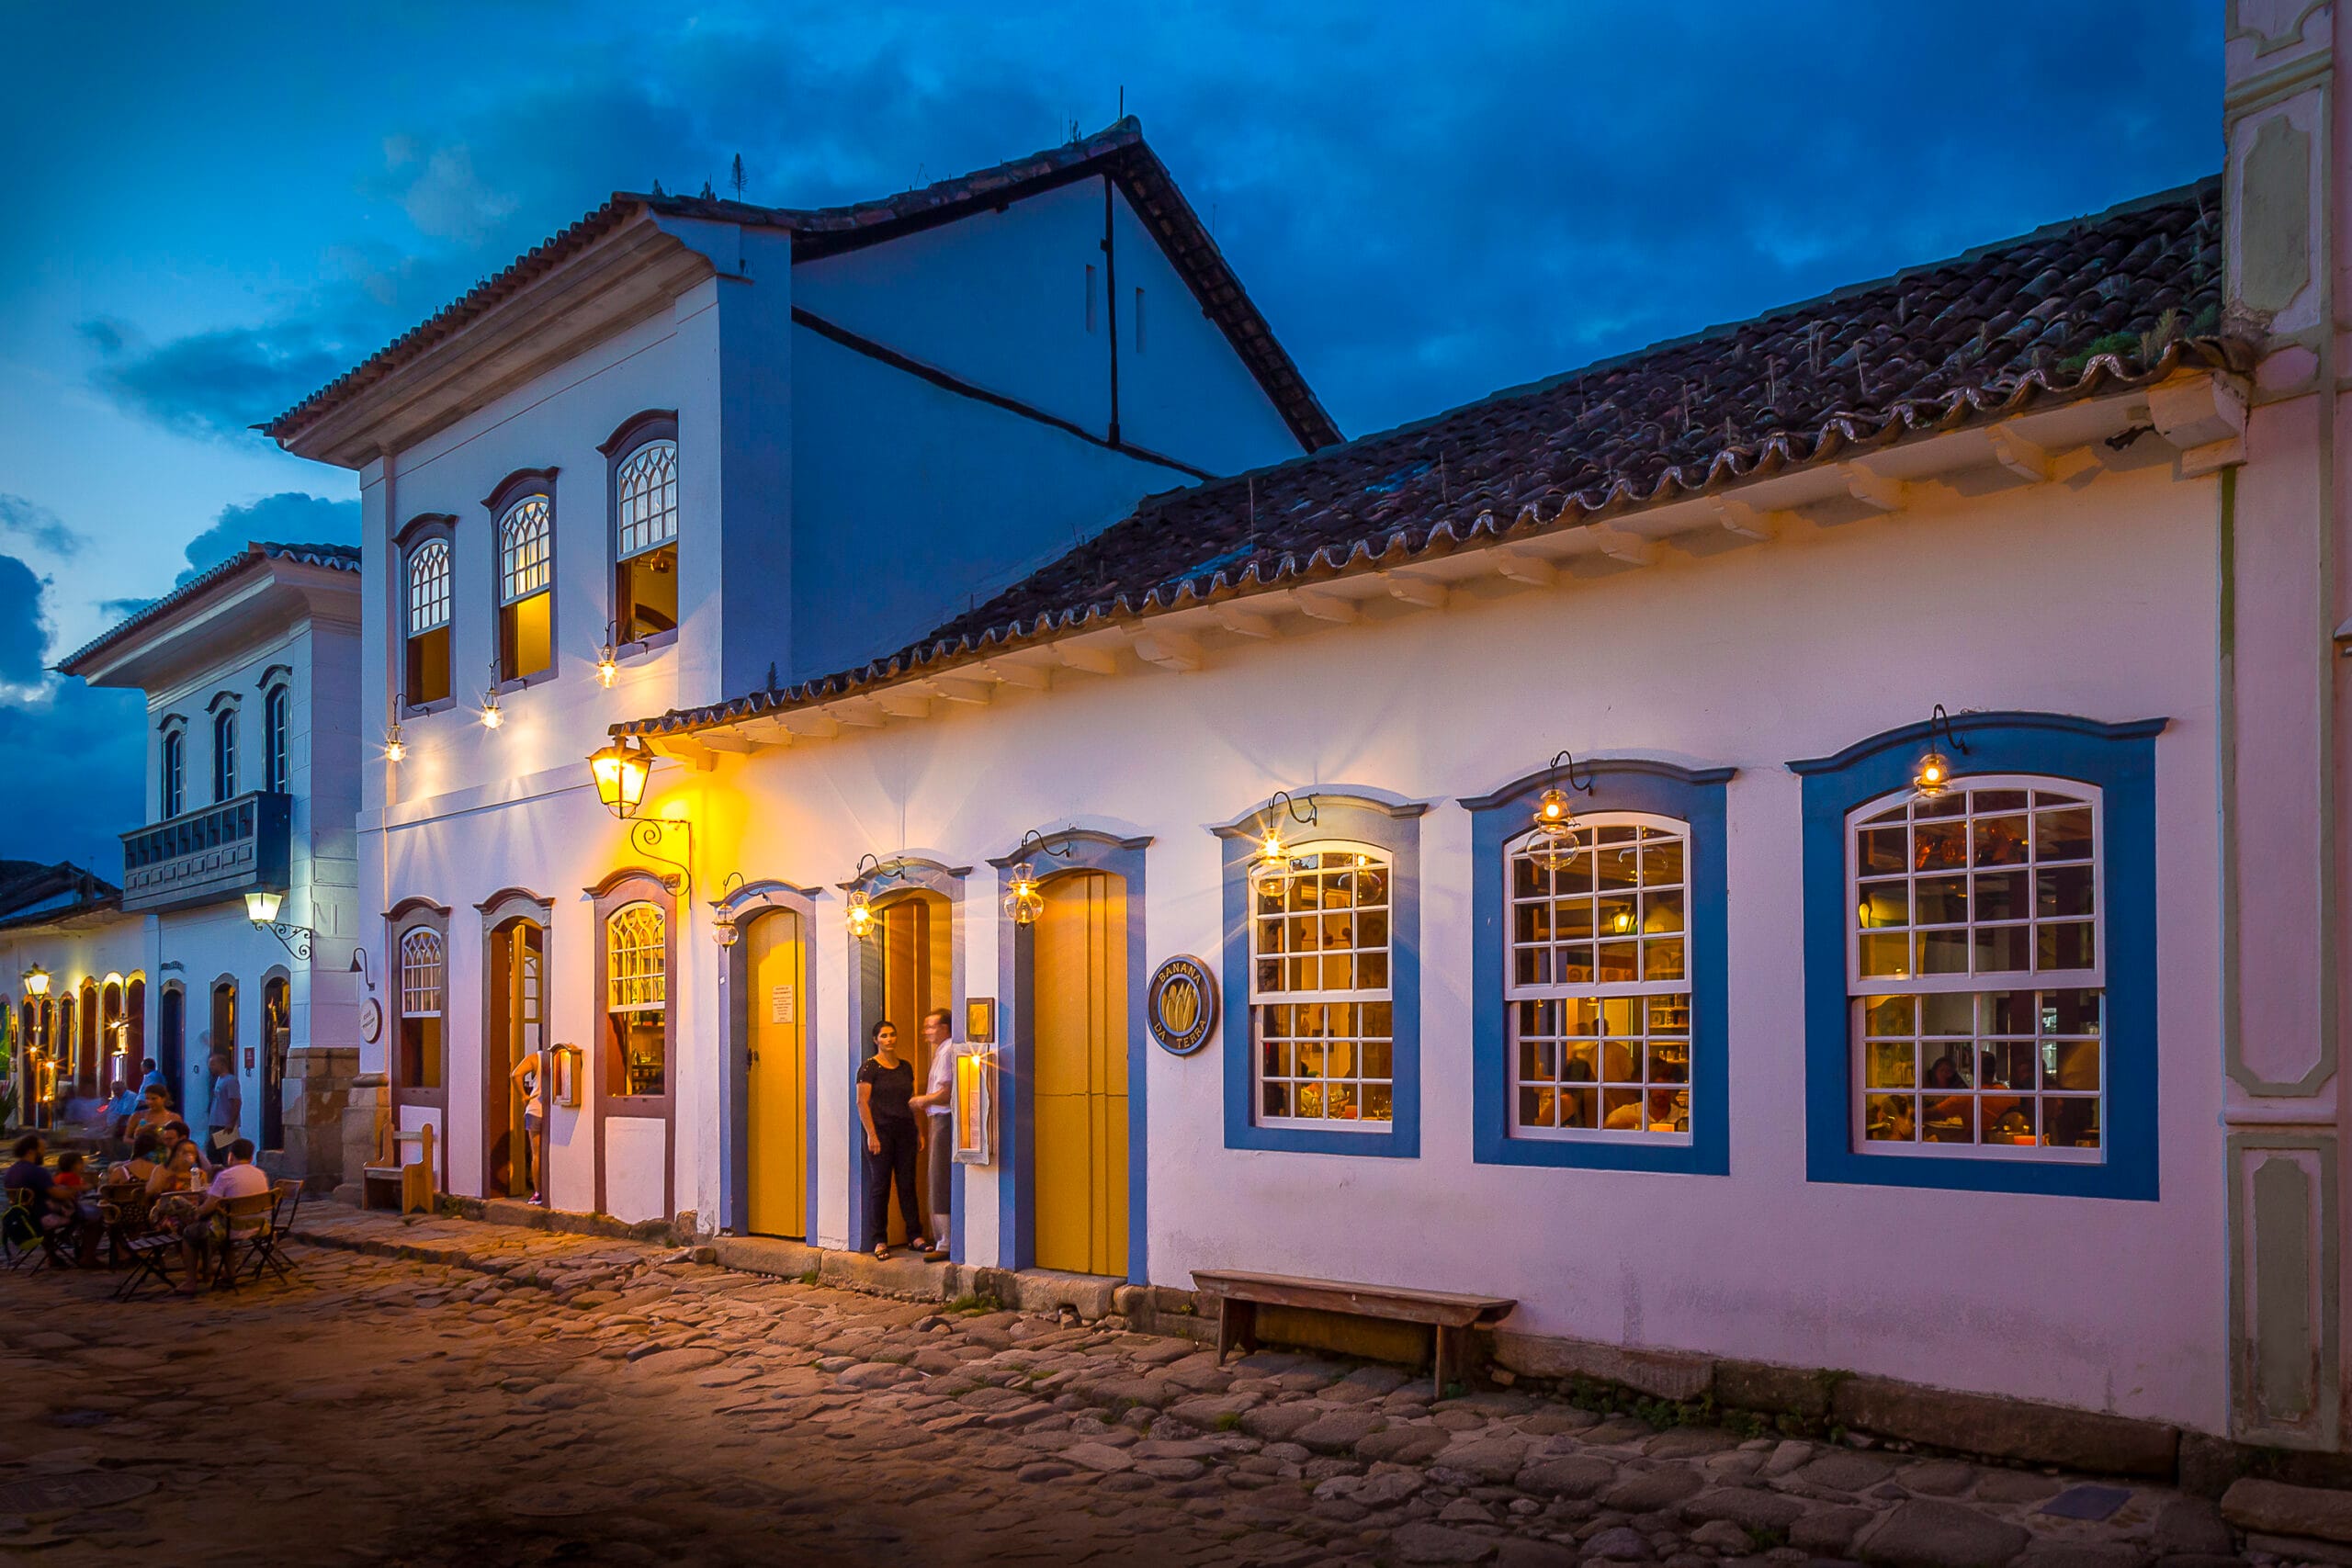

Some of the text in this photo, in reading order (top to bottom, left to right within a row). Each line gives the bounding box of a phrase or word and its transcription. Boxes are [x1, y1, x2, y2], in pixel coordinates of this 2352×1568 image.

[1159, 963, 1201, 985] BANANA
[1154, 1021, 1206, 1049] DA TERRA
